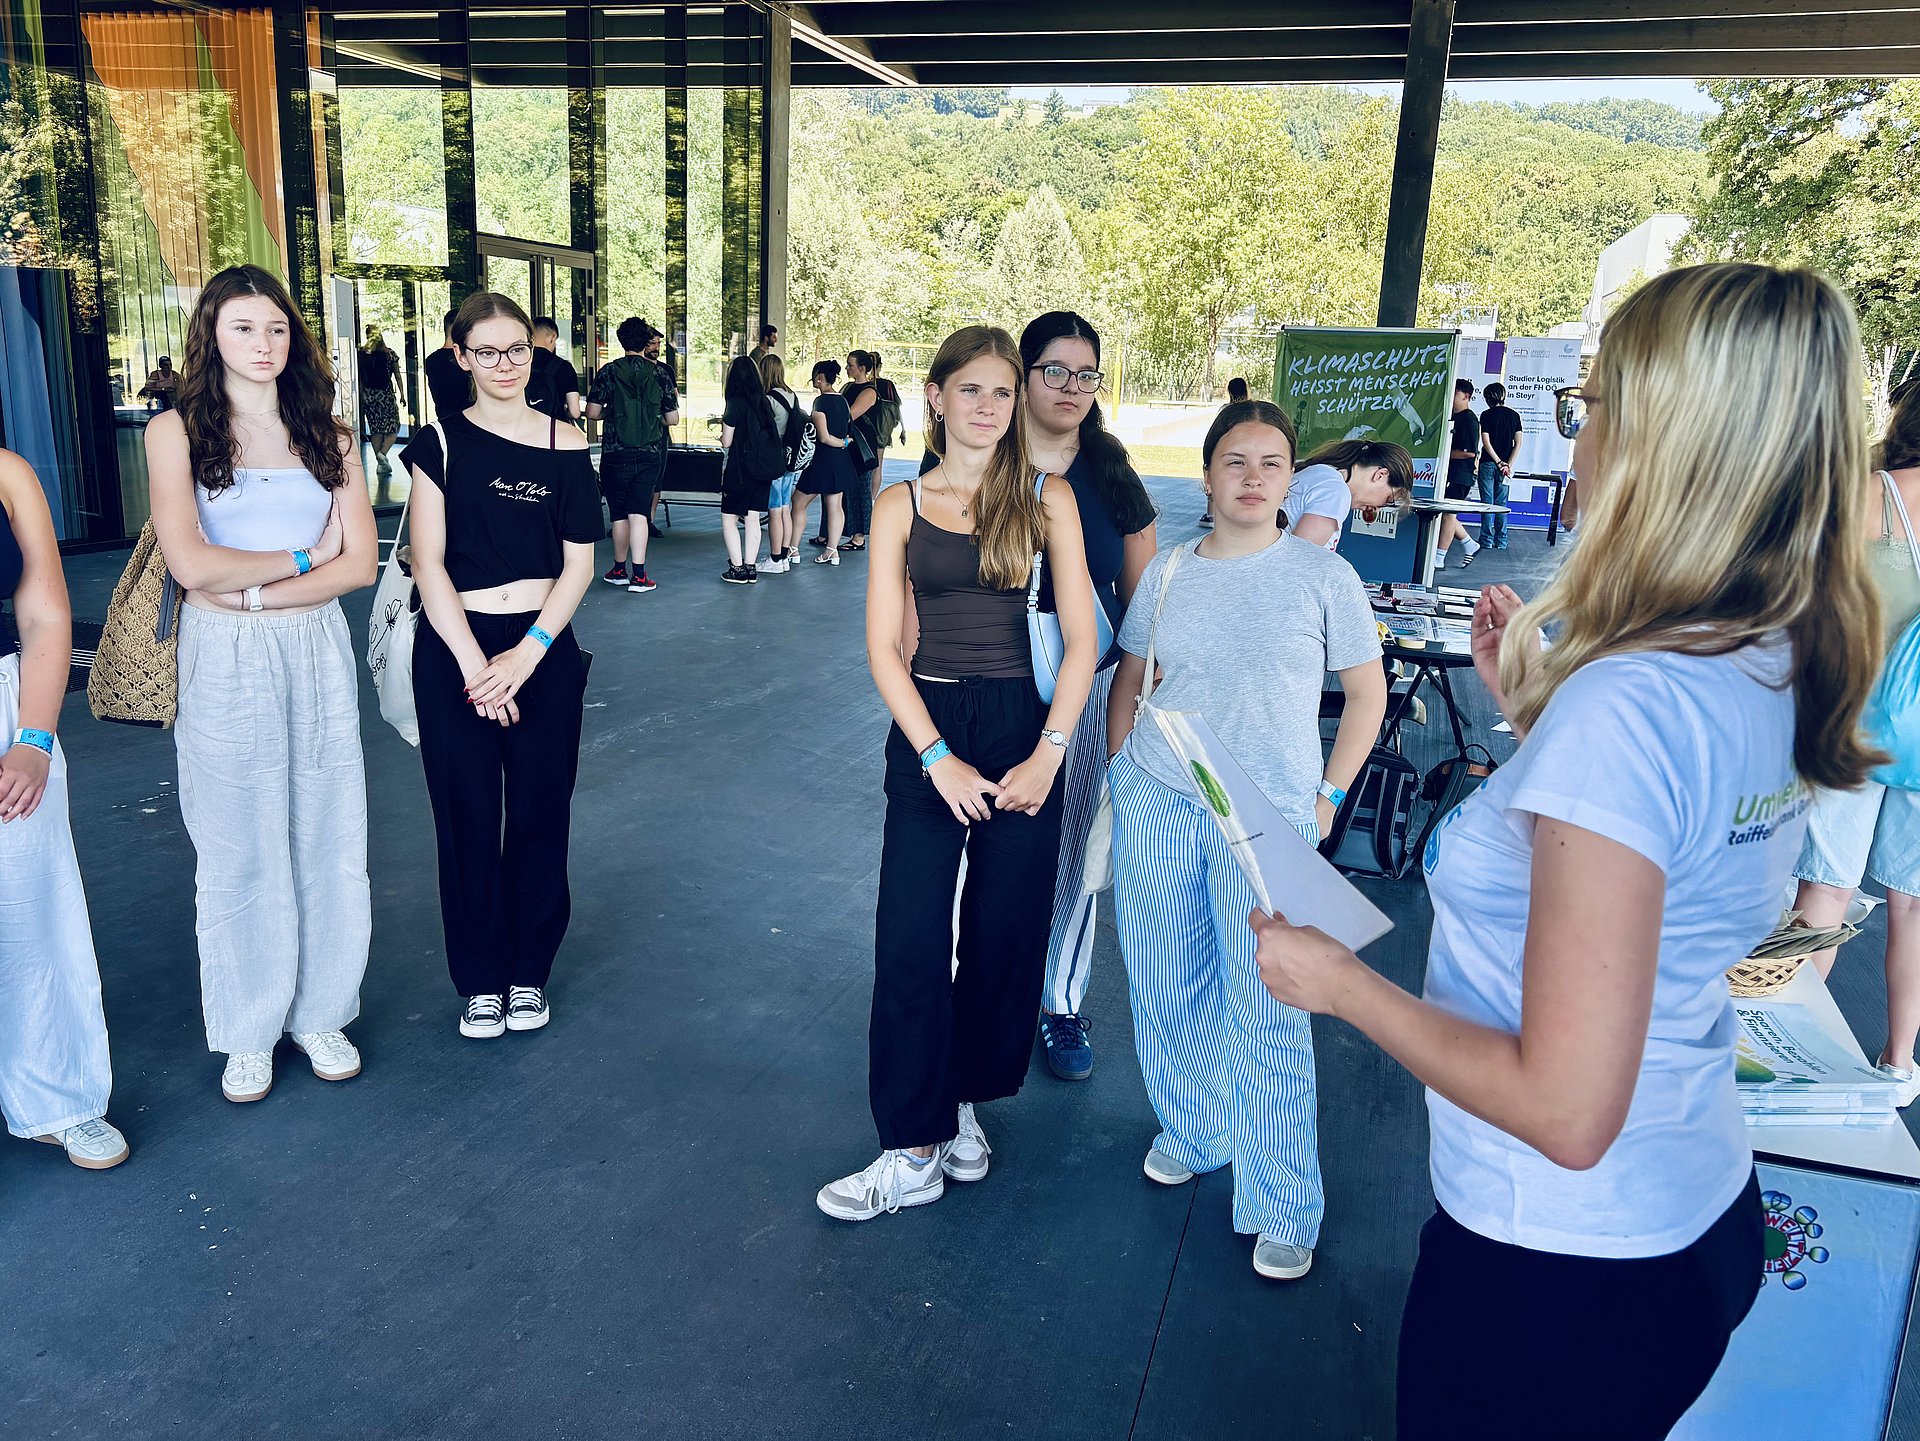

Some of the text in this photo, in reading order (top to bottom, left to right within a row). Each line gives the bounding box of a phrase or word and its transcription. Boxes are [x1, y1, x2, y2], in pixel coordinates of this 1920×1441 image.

[1288, 344, 1448, 376] KLIMASCHUTZ
[1290, 370, 1447, 397] HEISST MENSCHEN
[1508, 375, 1566, 386] Studier Logistik
[1317, 392, 1414, 415] SCHÜTZEN!
[1516, 392, 1535, 400] Steyr
[1743, 1018, 1794, 1064] Finanzieren
[1750, 1010, 1783, 1044] Sparen,
[1782, 1046, 1828, 1075] Bezahlen
